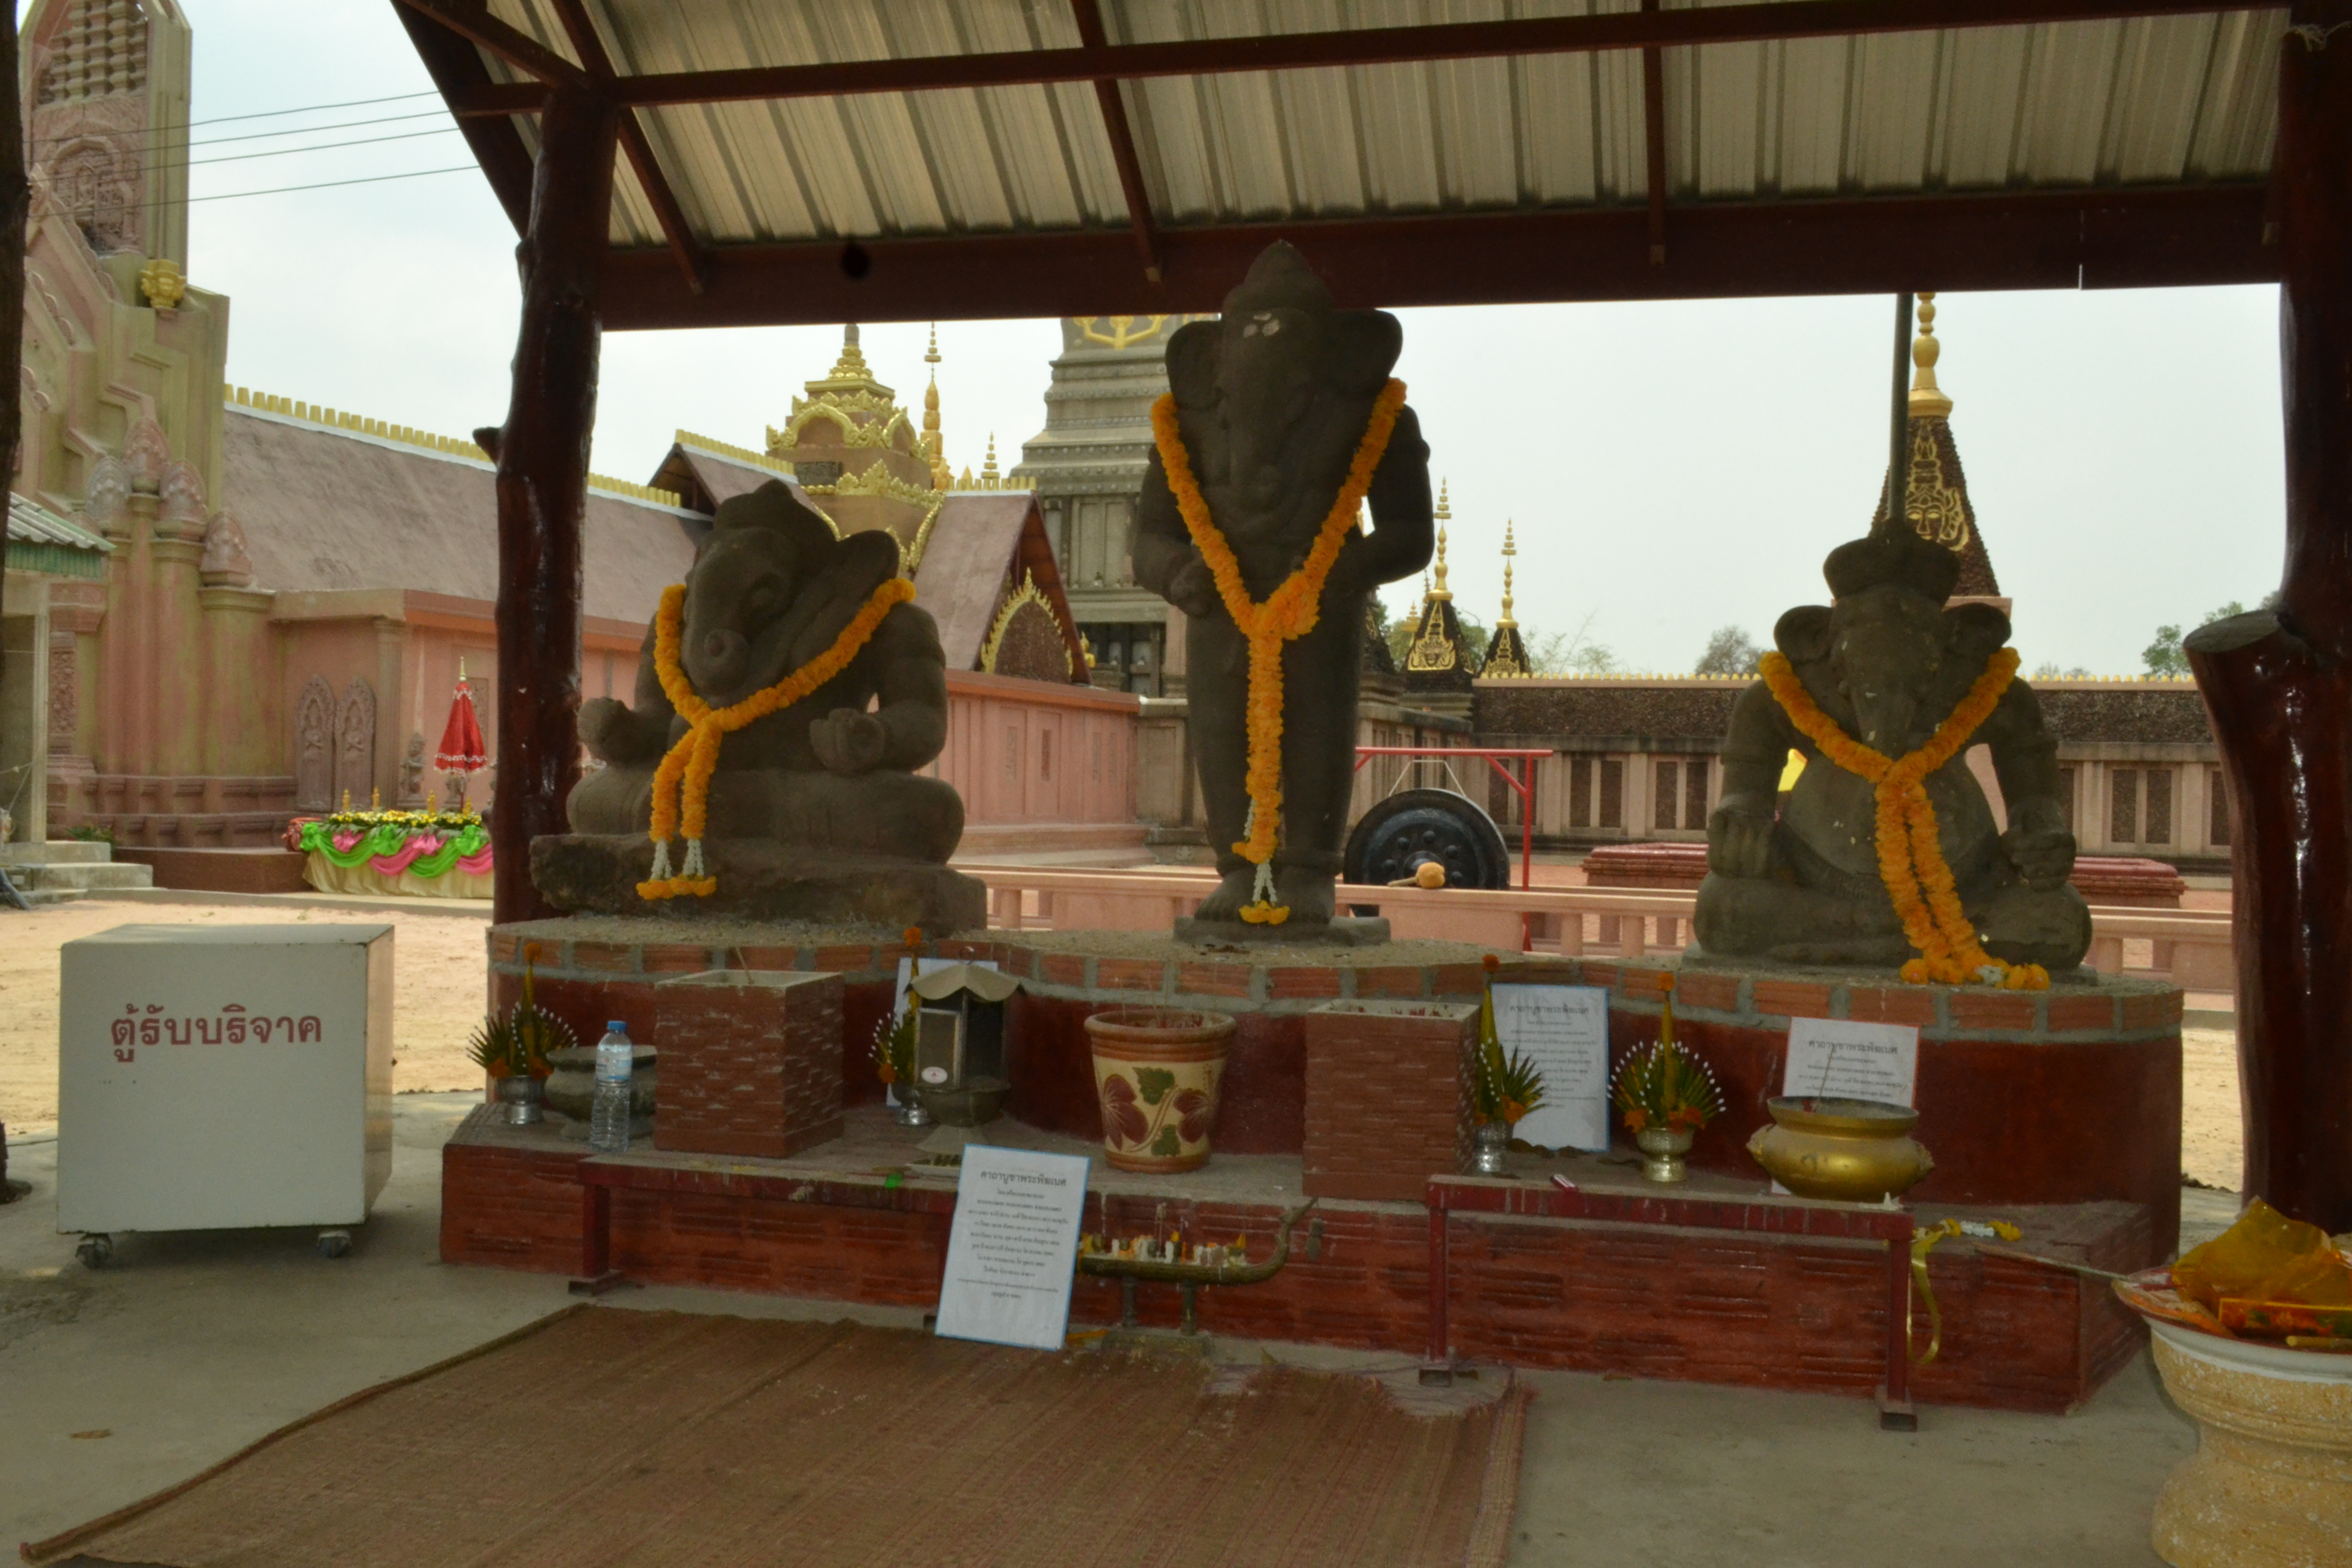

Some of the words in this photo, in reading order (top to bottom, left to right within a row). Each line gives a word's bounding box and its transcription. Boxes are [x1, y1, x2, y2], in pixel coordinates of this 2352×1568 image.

[111, 1002, 322, 1063] ตู้รับบริจาค
